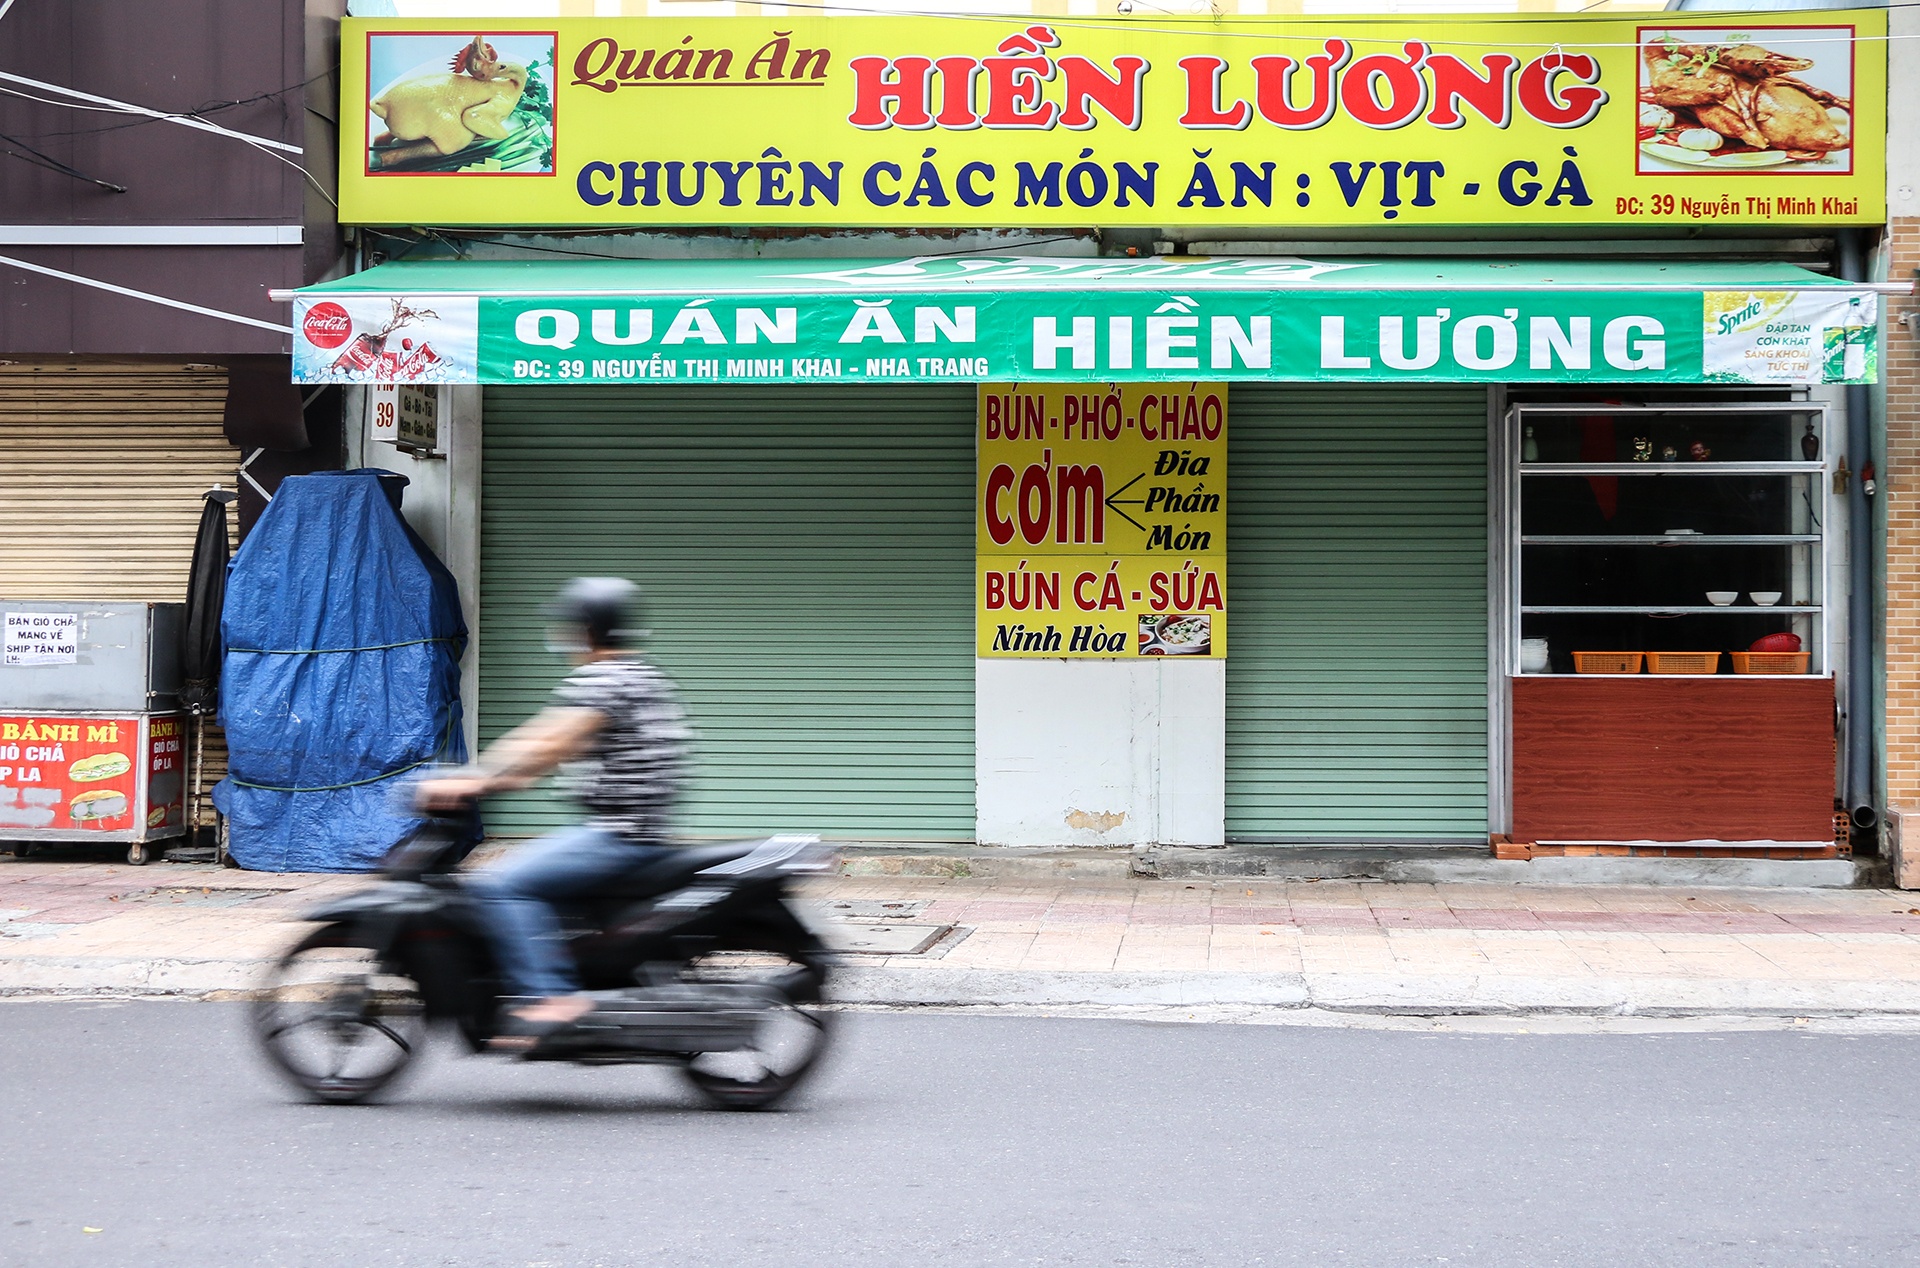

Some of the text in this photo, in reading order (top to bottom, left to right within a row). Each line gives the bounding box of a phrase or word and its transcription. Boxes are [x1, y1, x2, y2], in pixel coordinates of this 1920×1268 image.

[571, 30, 831, 93] Quán Ăn
[847, 25, 1610, 130] HIỀN LƯƠNG
[577, 146, 844, 207] CHUYÊN
[862, 147, 995, 207] CÁC
[1014, 147, 1159, 208] MÓN
[1177, 147, 1276, 208] ĂN
[1330, 161, 1445, 219] VỊT
[1497, 146, 1594, 207] GÀ
[1615, 193, 1858, 219] ĐC: 39 Nguyễn Thị Minh Khai
[842, 256, 1313, 280] Sprite
[515, 298, 976, 350] QUÁN ĂN
[1717, 301, 1762, 335] Sprite
[1766, 322, 1811, 334] ĐẬP TAN
[1031, 296, 1666, 370] HIỀN LƯƠNG
[1756, 335, 1811, 346] CƠN KHÁT
[513, 359, 550, 378] ĐC:
[558, 359, 584, 378] 39
[592, 352, 676, 378] NGUYỄN
[684, 359, 719, 381] THỊ
[727, 359, 783, 378] MINH
[792, 358, 841, 377] KHAI
[866, 358, 911, 376] NHA
[917, 357, 988, 376] TRANG
[376, 402, 394, 428] 39
[985, 383, 1044, 441] BÚN
[1063, 383, 1123, 441] PHỞ
[1139, 383, 1223, 441] CHÁO
[1154, 449, 1211, 477] Đĩa
[1144, 482, 1220, 514] Phần
[1145, 522, 1211, 551] Món
[985, 560, 1060, 612] BÚN
[1072, 560, 1127, 612] CÁ
[1149, 560, 1225, 612] SỨA
[8, 615, 30, 626] BÁN
[33, 615, 50, 626] GIÒ
[6, 643, 75, 655] SHIP TẬN NƠI
[17, 631, 47, 640] MANG
[992, 622, 1128, 652] Ninh Hòa
[2, 719, 119, 743] BÁNH MÌ
[150, 720, 173, 738] BÁNH
[0, 742, 65, 762] IÒ CHẢ
[163, 757, 172, 770] LA
[0, 766, 42, 782] P LA
